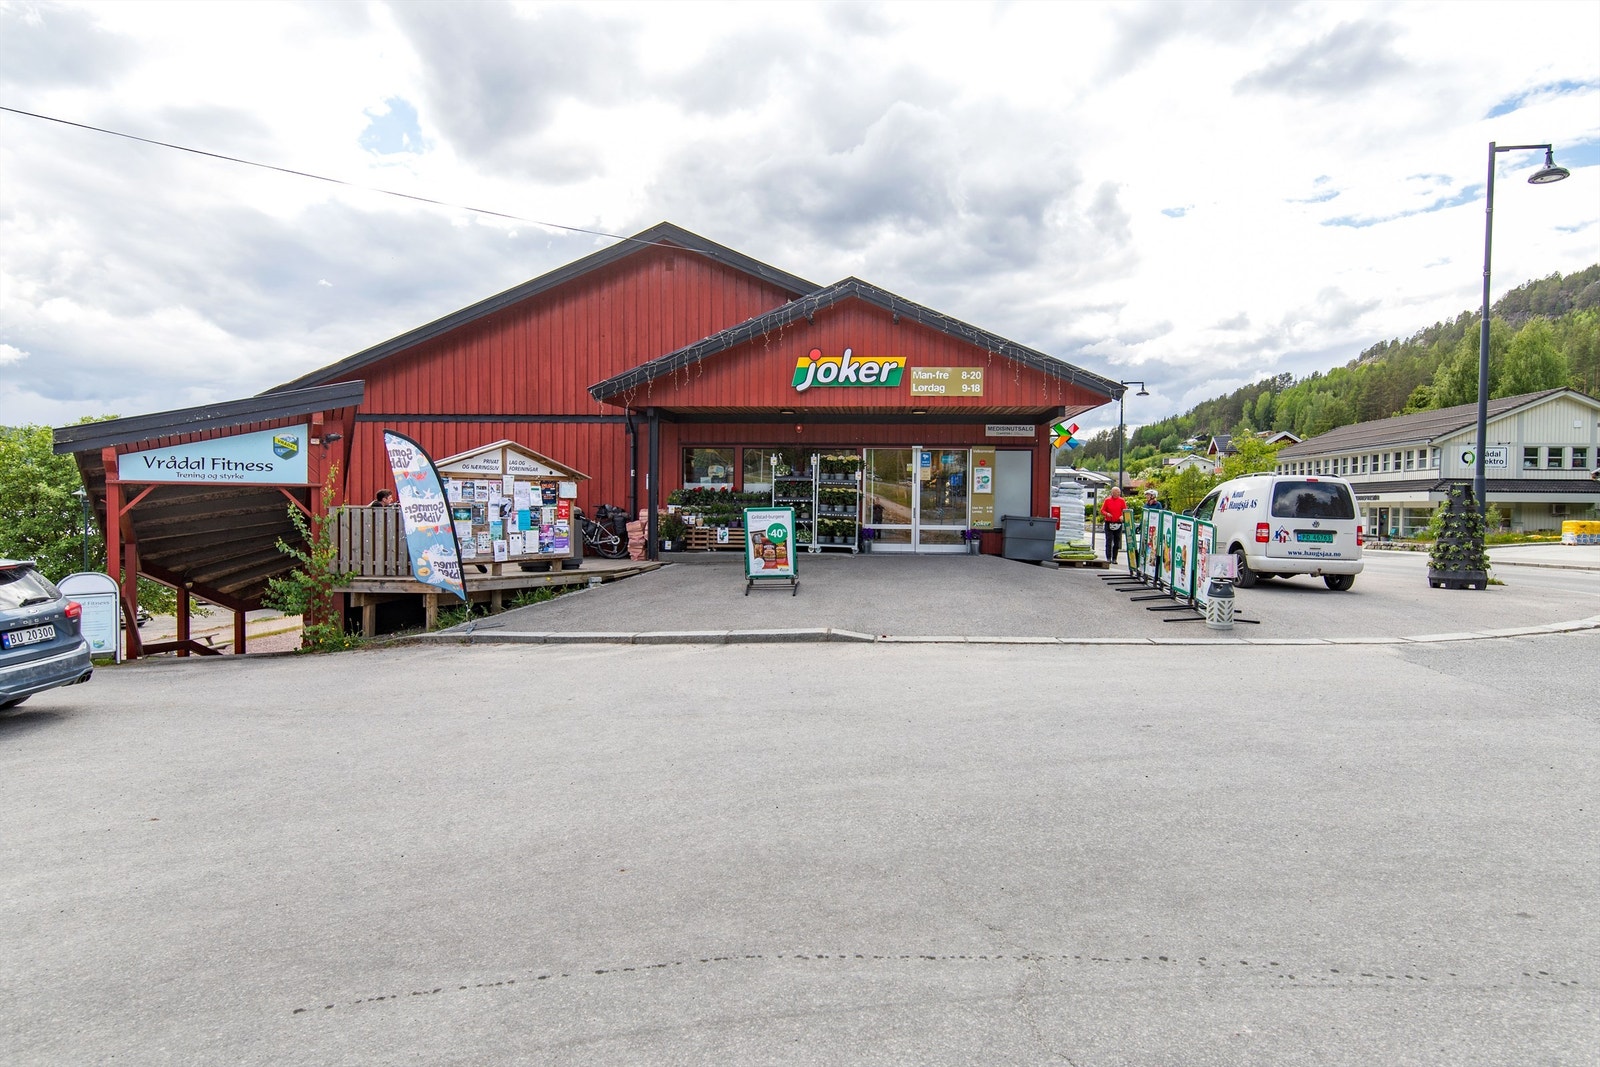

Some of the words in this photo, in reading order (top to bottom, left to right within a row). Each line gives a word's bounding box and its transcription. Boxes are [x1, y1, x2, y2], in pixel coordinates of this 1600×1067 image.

[795, 348, 899, 392] joker
[912, 371, 949, 380] Man-fre
[961, 371, 982, 380] 8-20
[912, 383, 946, 394] Lørdag
[961, 384, 981, 393] 9-18
[1485, 450, 1501, 458] ådal
[143, 455, 205, 471] Vrådal
[211, 457, 274, 472] Fitness
[176, 472, 206, 480] Trening
[219, 472, 245, 480] styrke
[1232, 490, 1245, 498] Knut
[1249, 499, 1258, 509] AS
[1288, 550, 1342, 558] www.haugsjaa.no
[10, 632, 23, 644] BU
[26, 626, 54, 641] 20300
